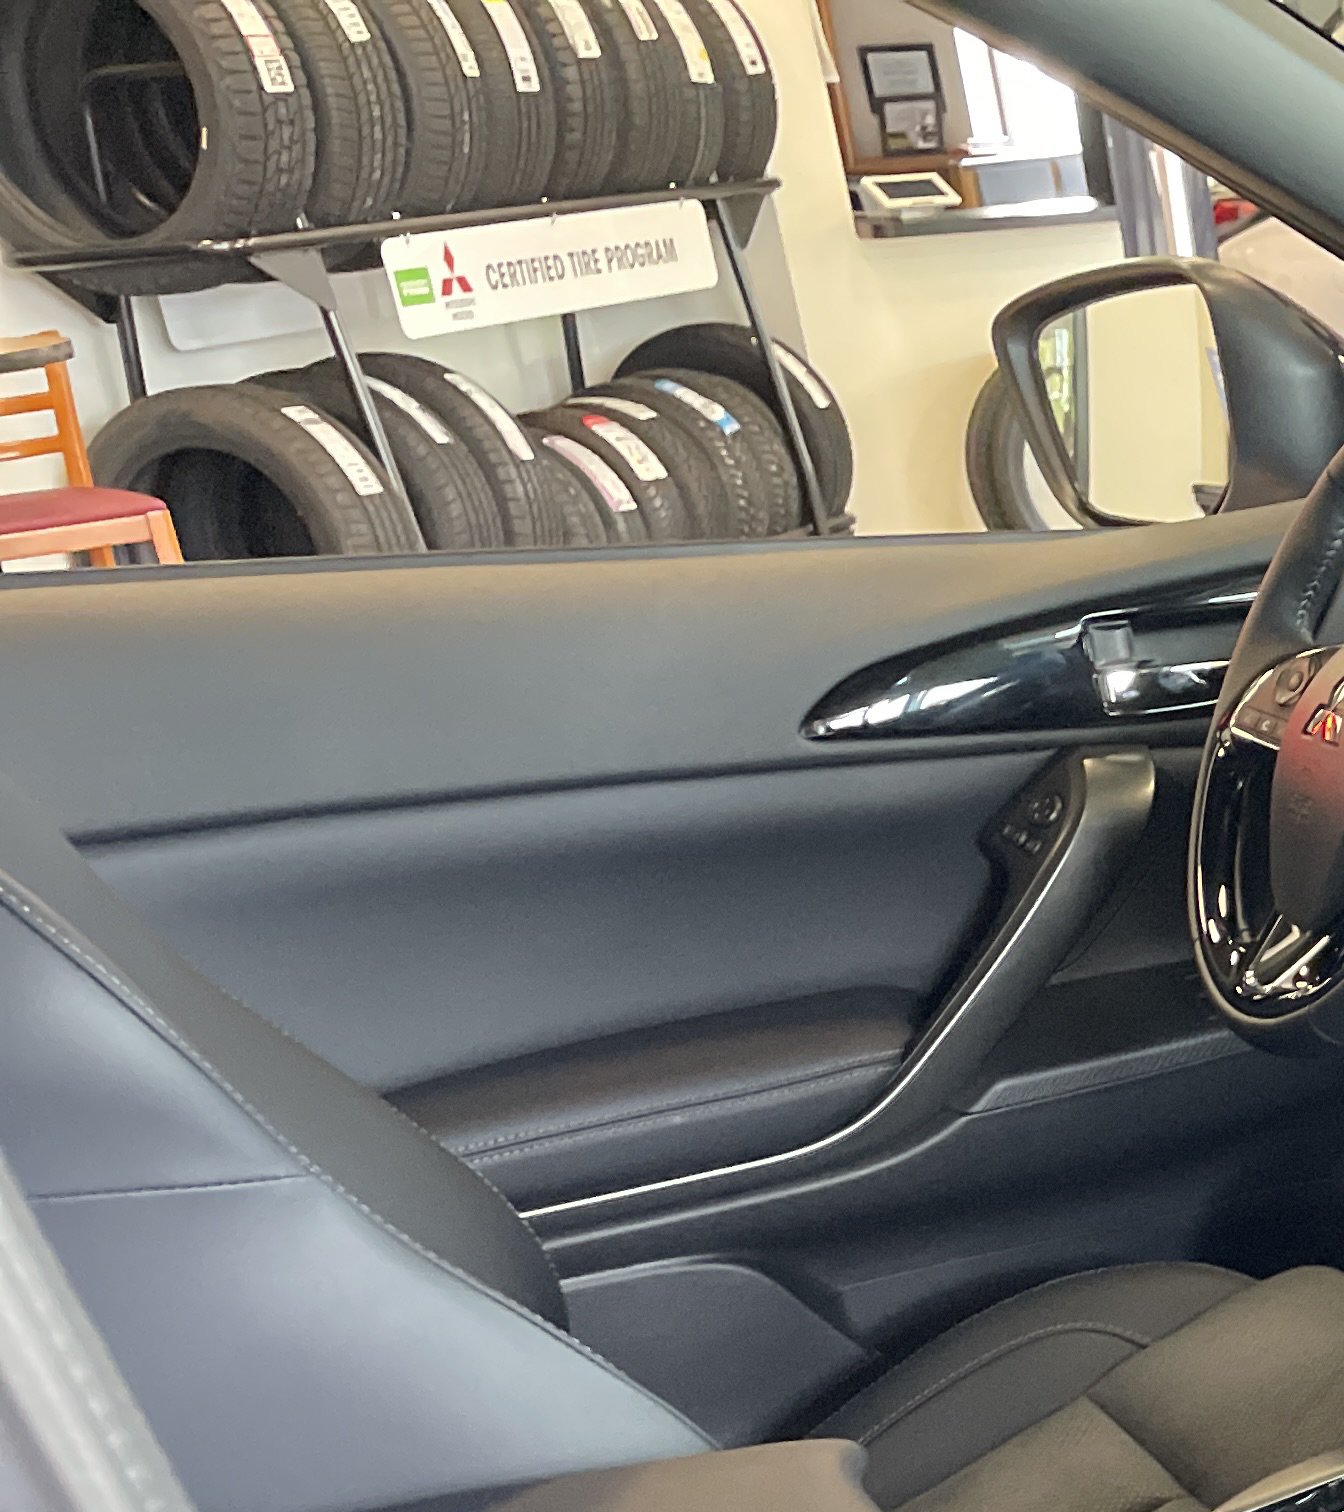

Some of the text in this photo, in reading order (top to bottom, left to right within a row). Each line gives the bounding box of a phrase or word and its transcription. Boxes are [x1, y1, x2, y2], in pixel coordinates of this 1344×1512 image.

[485, 237, 679, 291] CERTIFIED TIRE PROGRAM
